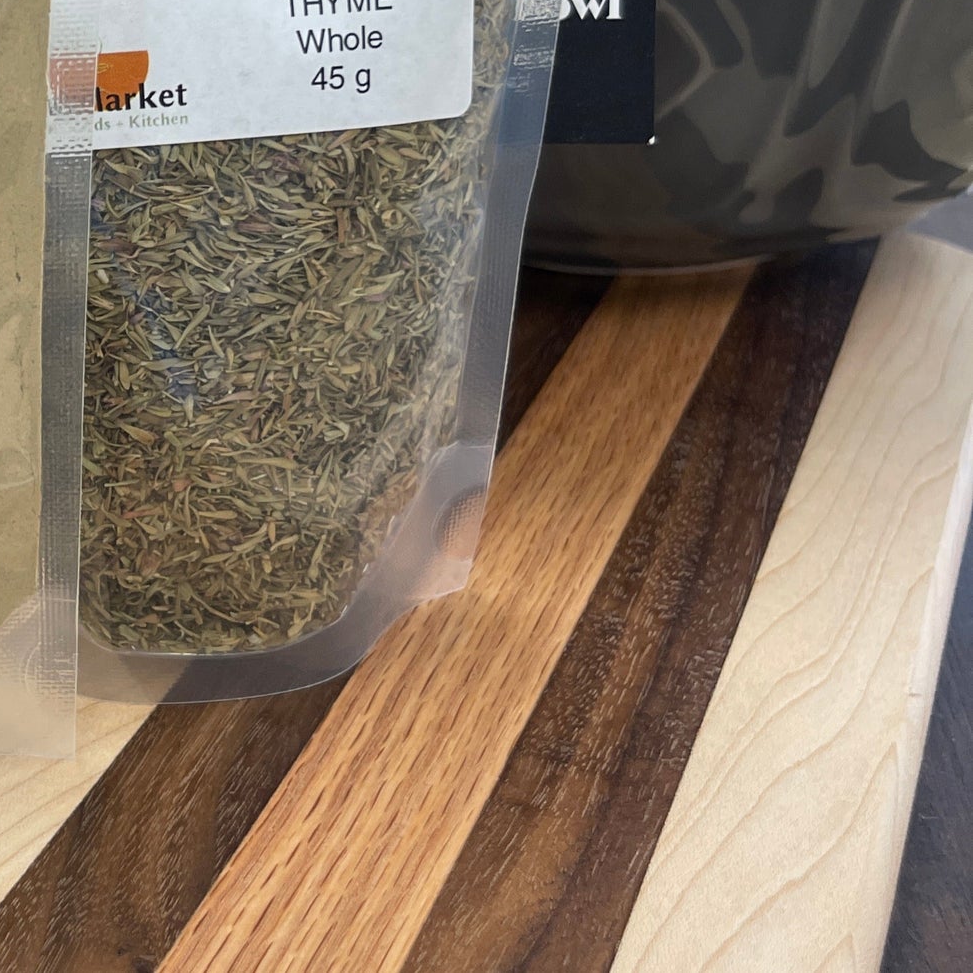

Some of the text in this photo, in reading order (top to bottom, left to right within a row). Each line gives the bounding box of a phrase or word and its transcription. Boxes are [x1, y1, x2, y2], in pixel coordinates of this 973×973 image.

[296, 25, 383, 54] Whole
[311, 65, 371, 94] 45 g
[129, 113, 189, 129] Kitchen
